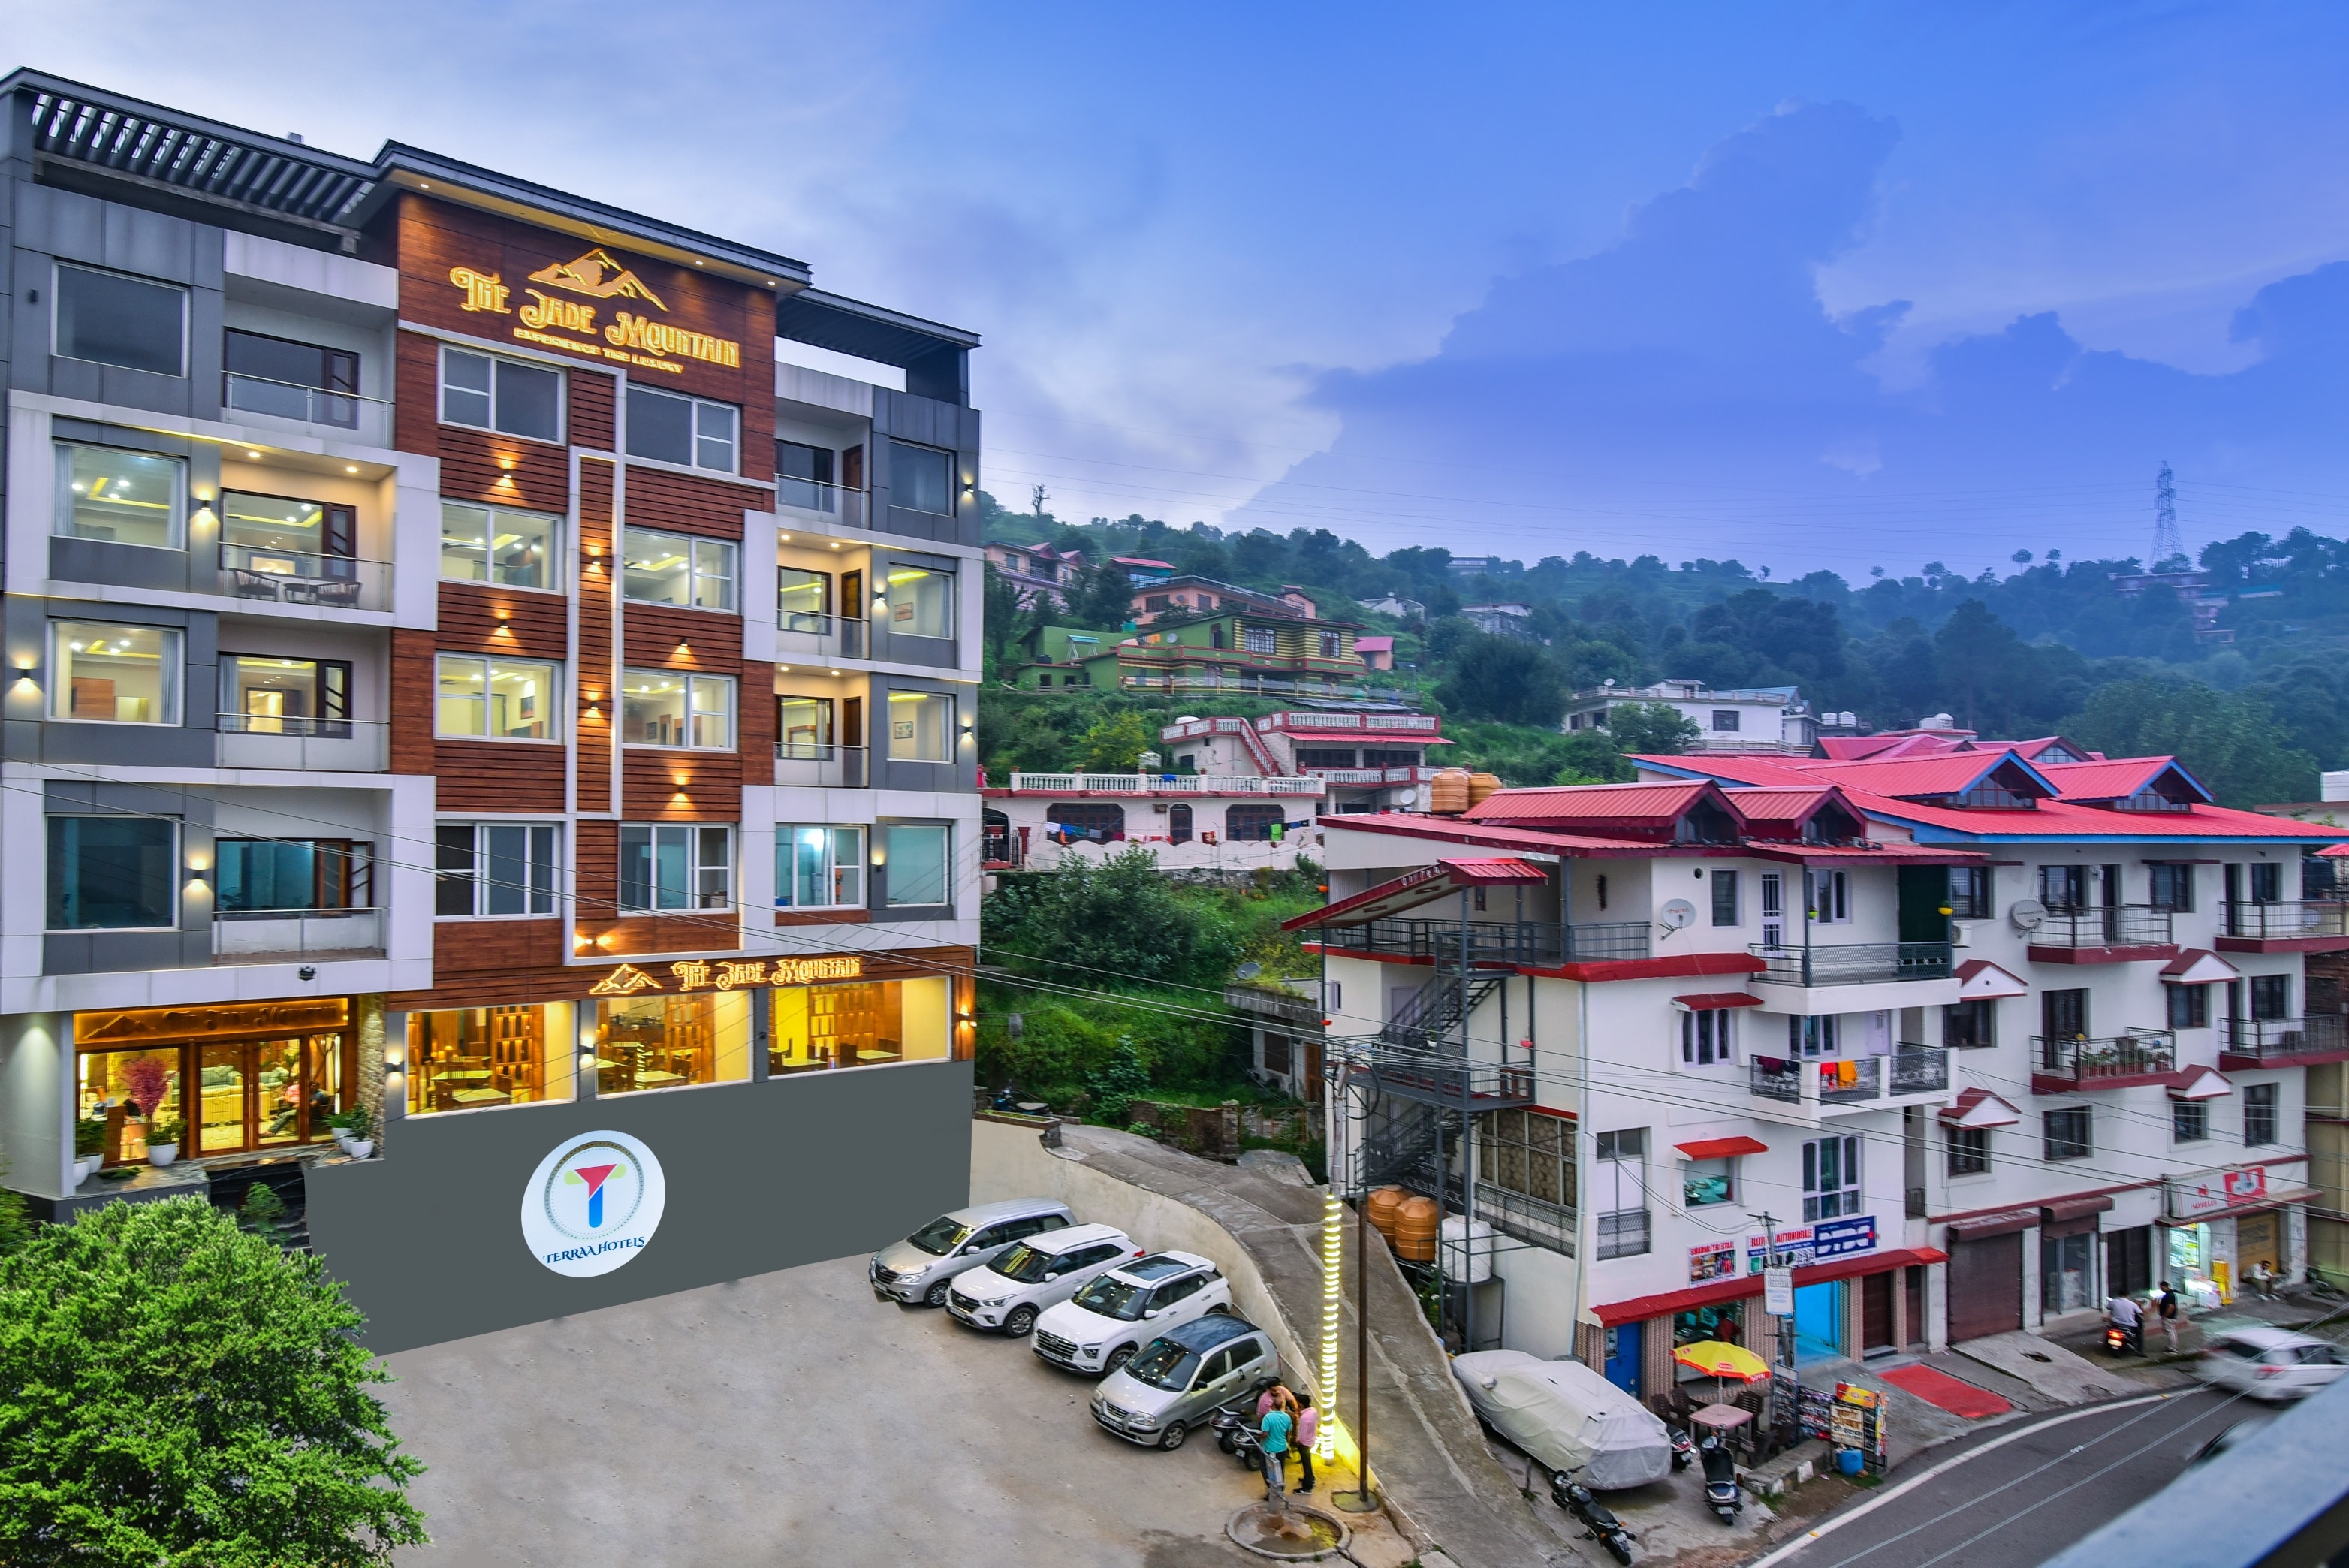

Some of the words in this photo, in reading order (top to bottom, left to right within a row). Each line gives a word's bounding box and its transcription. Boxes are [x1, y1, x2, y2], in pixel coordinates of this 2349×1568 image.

[514, 327, 602, 356] EXPERIENCE
[602, 348, 631, 363] THE
[632, 354, 684, 374] LUXURY
[543, 1245, 598, 1264] TERRAA
[597, 1237, 644, 1254] HOTELS
